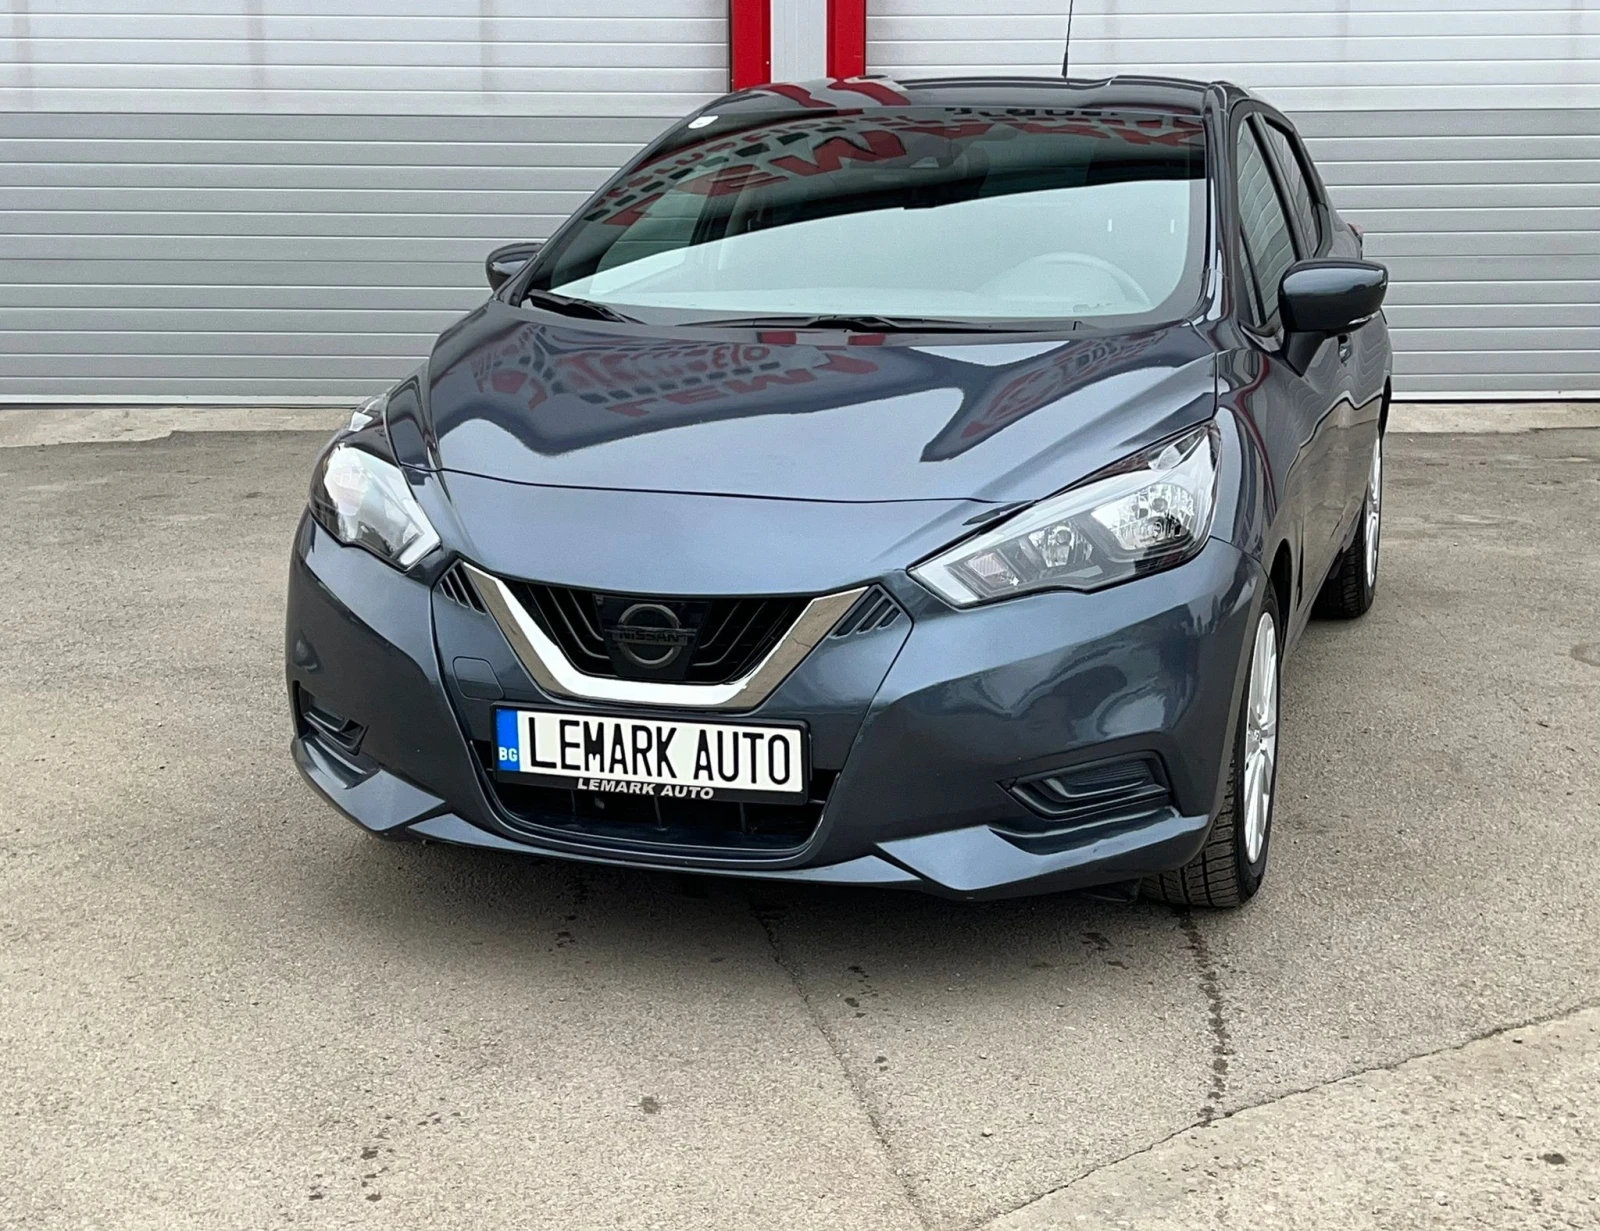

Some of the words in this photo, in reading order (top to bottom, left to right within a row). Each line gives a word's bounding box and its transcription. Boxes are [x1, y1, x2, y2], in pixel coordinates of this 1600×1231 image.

[618, 631, 681, 643] NISSAN
[498, 746, 518, 762] BG
[528, 716, 678, 779] LEMARK
[693, 728, 791, 786] AUTO
[577, 777, 656, 796] LEMARK
[660, 784, 715, 800] AUTO
